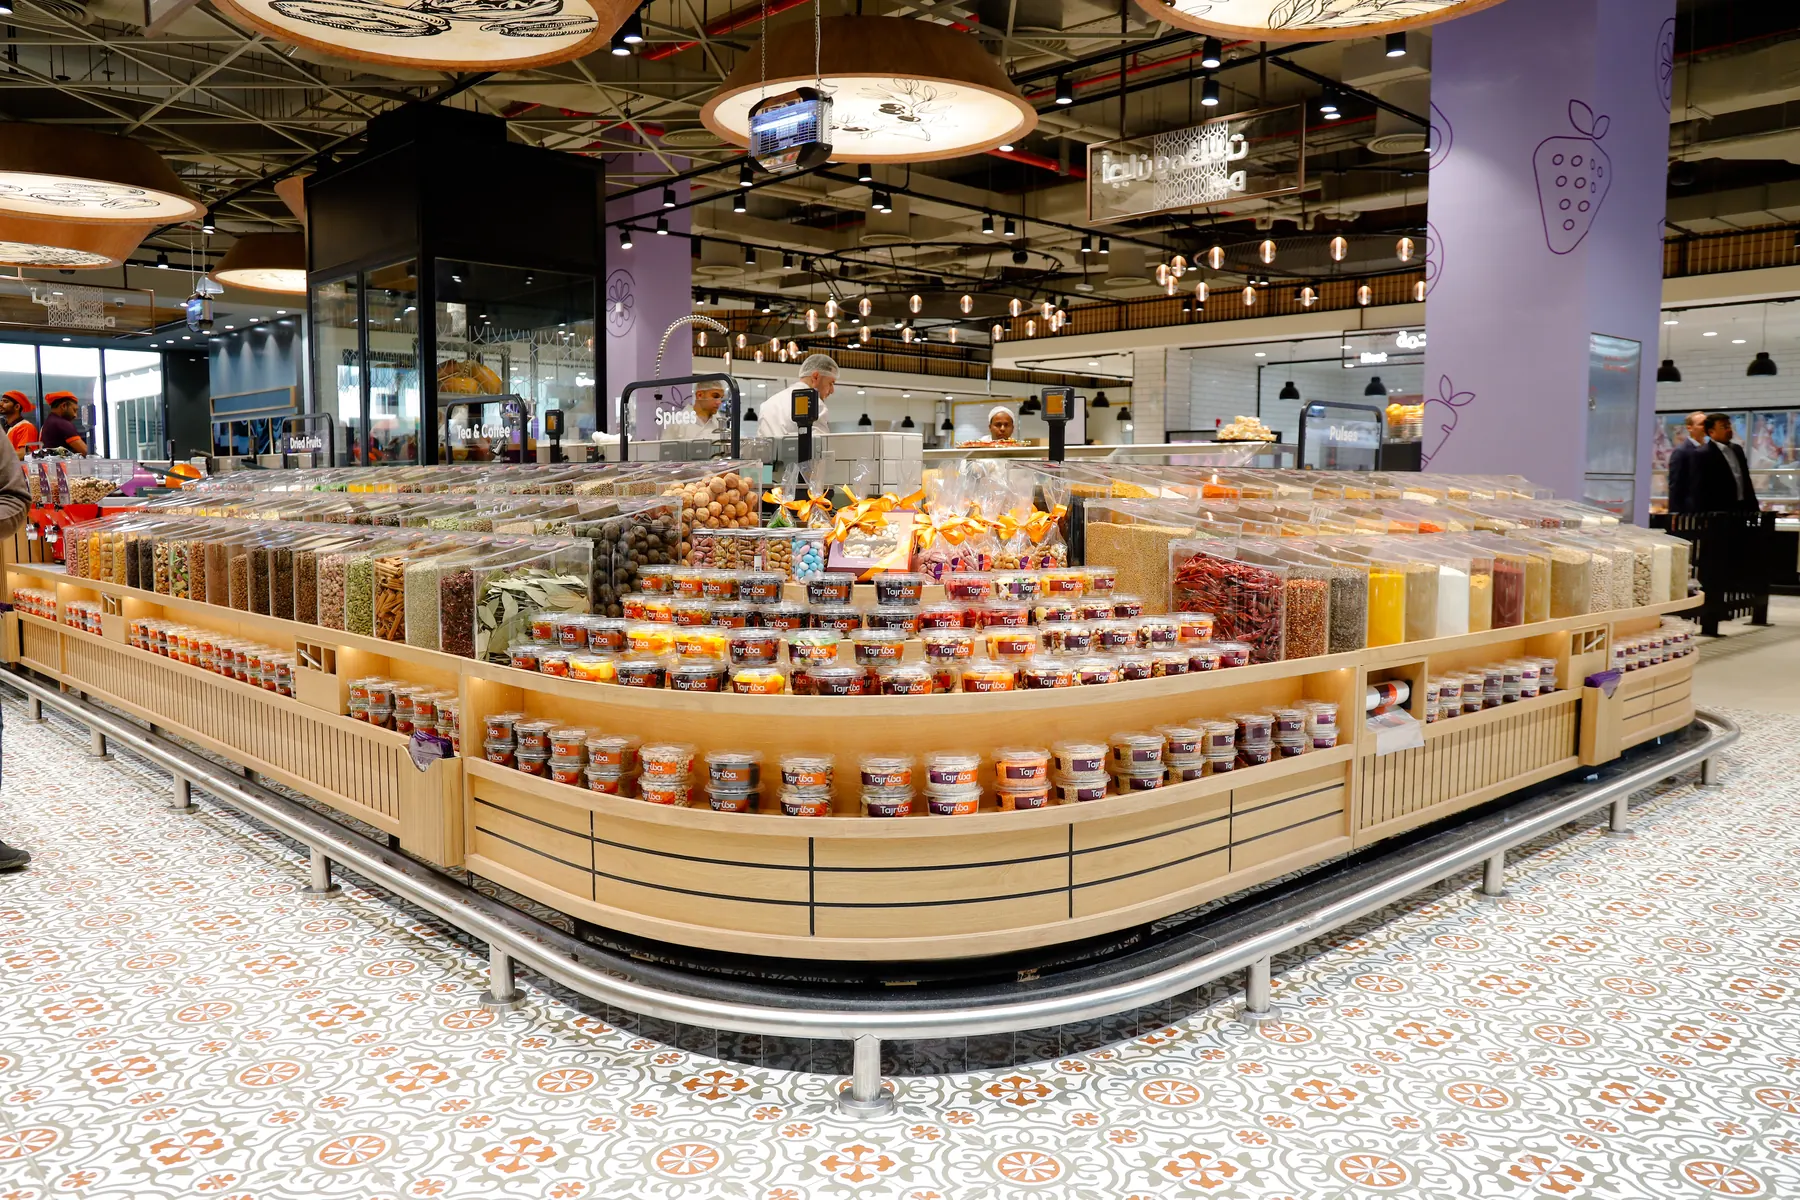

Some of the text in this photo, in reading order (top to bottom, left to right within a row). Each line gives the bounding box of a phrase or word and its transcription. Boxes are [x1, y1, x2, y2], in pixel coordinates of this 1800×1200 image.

[656, 407, 697, 429] Spices
[457, 424, 510, 439] Tea & Coffee
[1329, 426, 1358, 441] Pulses
[290, 437, 322, 449] Dried Fruits
